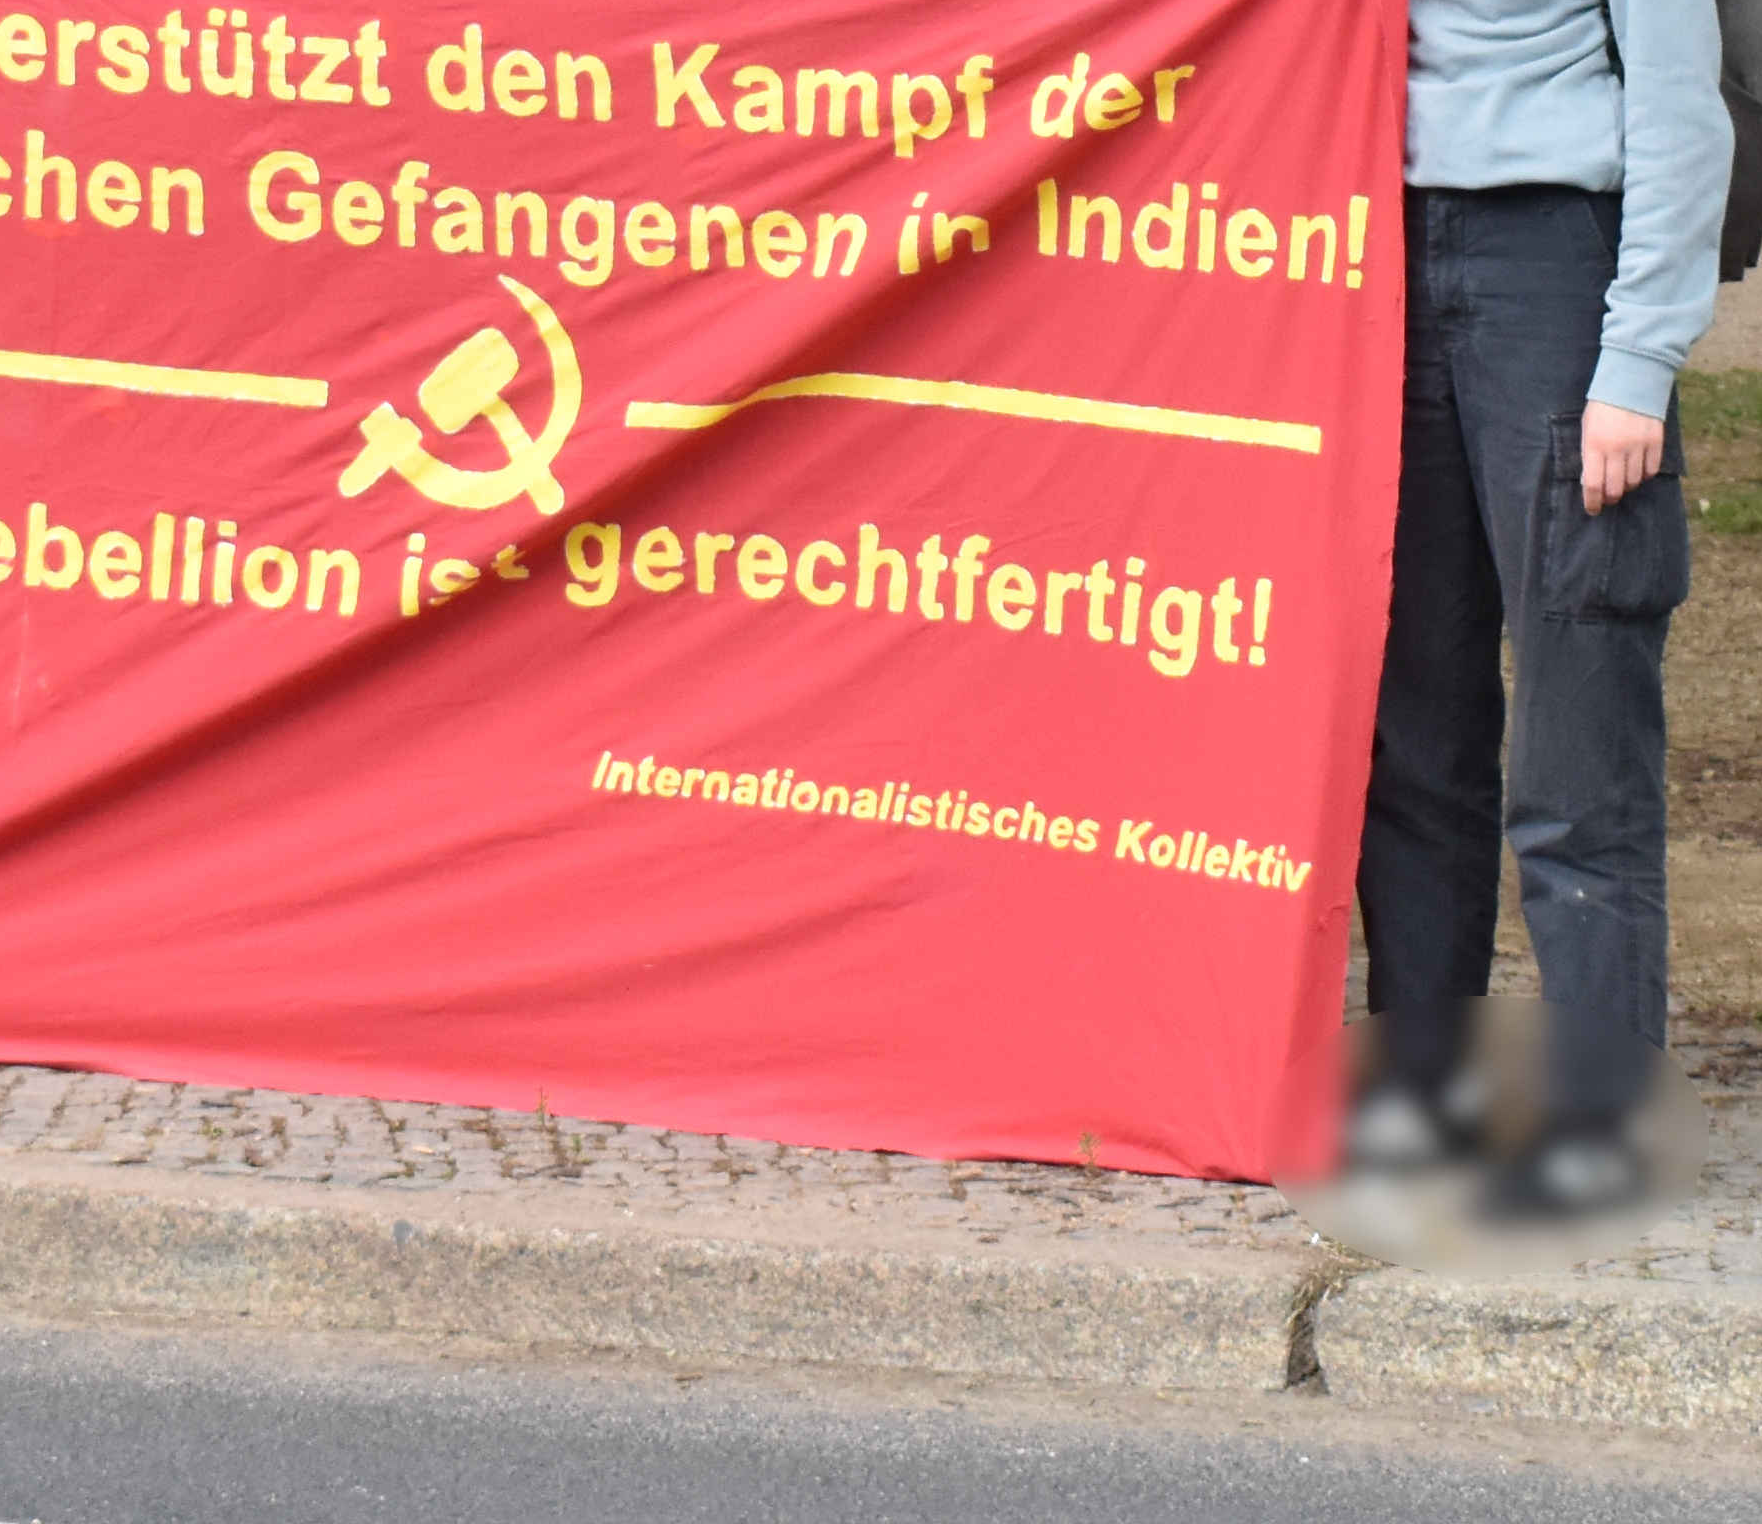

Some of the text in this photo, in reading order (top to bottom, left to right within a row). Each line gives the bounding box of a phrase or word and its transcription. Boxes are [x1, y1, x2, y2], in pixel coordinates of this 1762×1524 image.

[425, 23, 614, 123] den
[651, 40, 995, 160] Kampf
[1029, 51, 1197, 140] der
[247, 149, 869, 288] Gefangenen
[1036, 177, 1371, 290] Indien!
[563, 520, 1274, 679] gerechtfertigt!
[591, 749, 1313, 895] Internationalistisches Kollektiv
